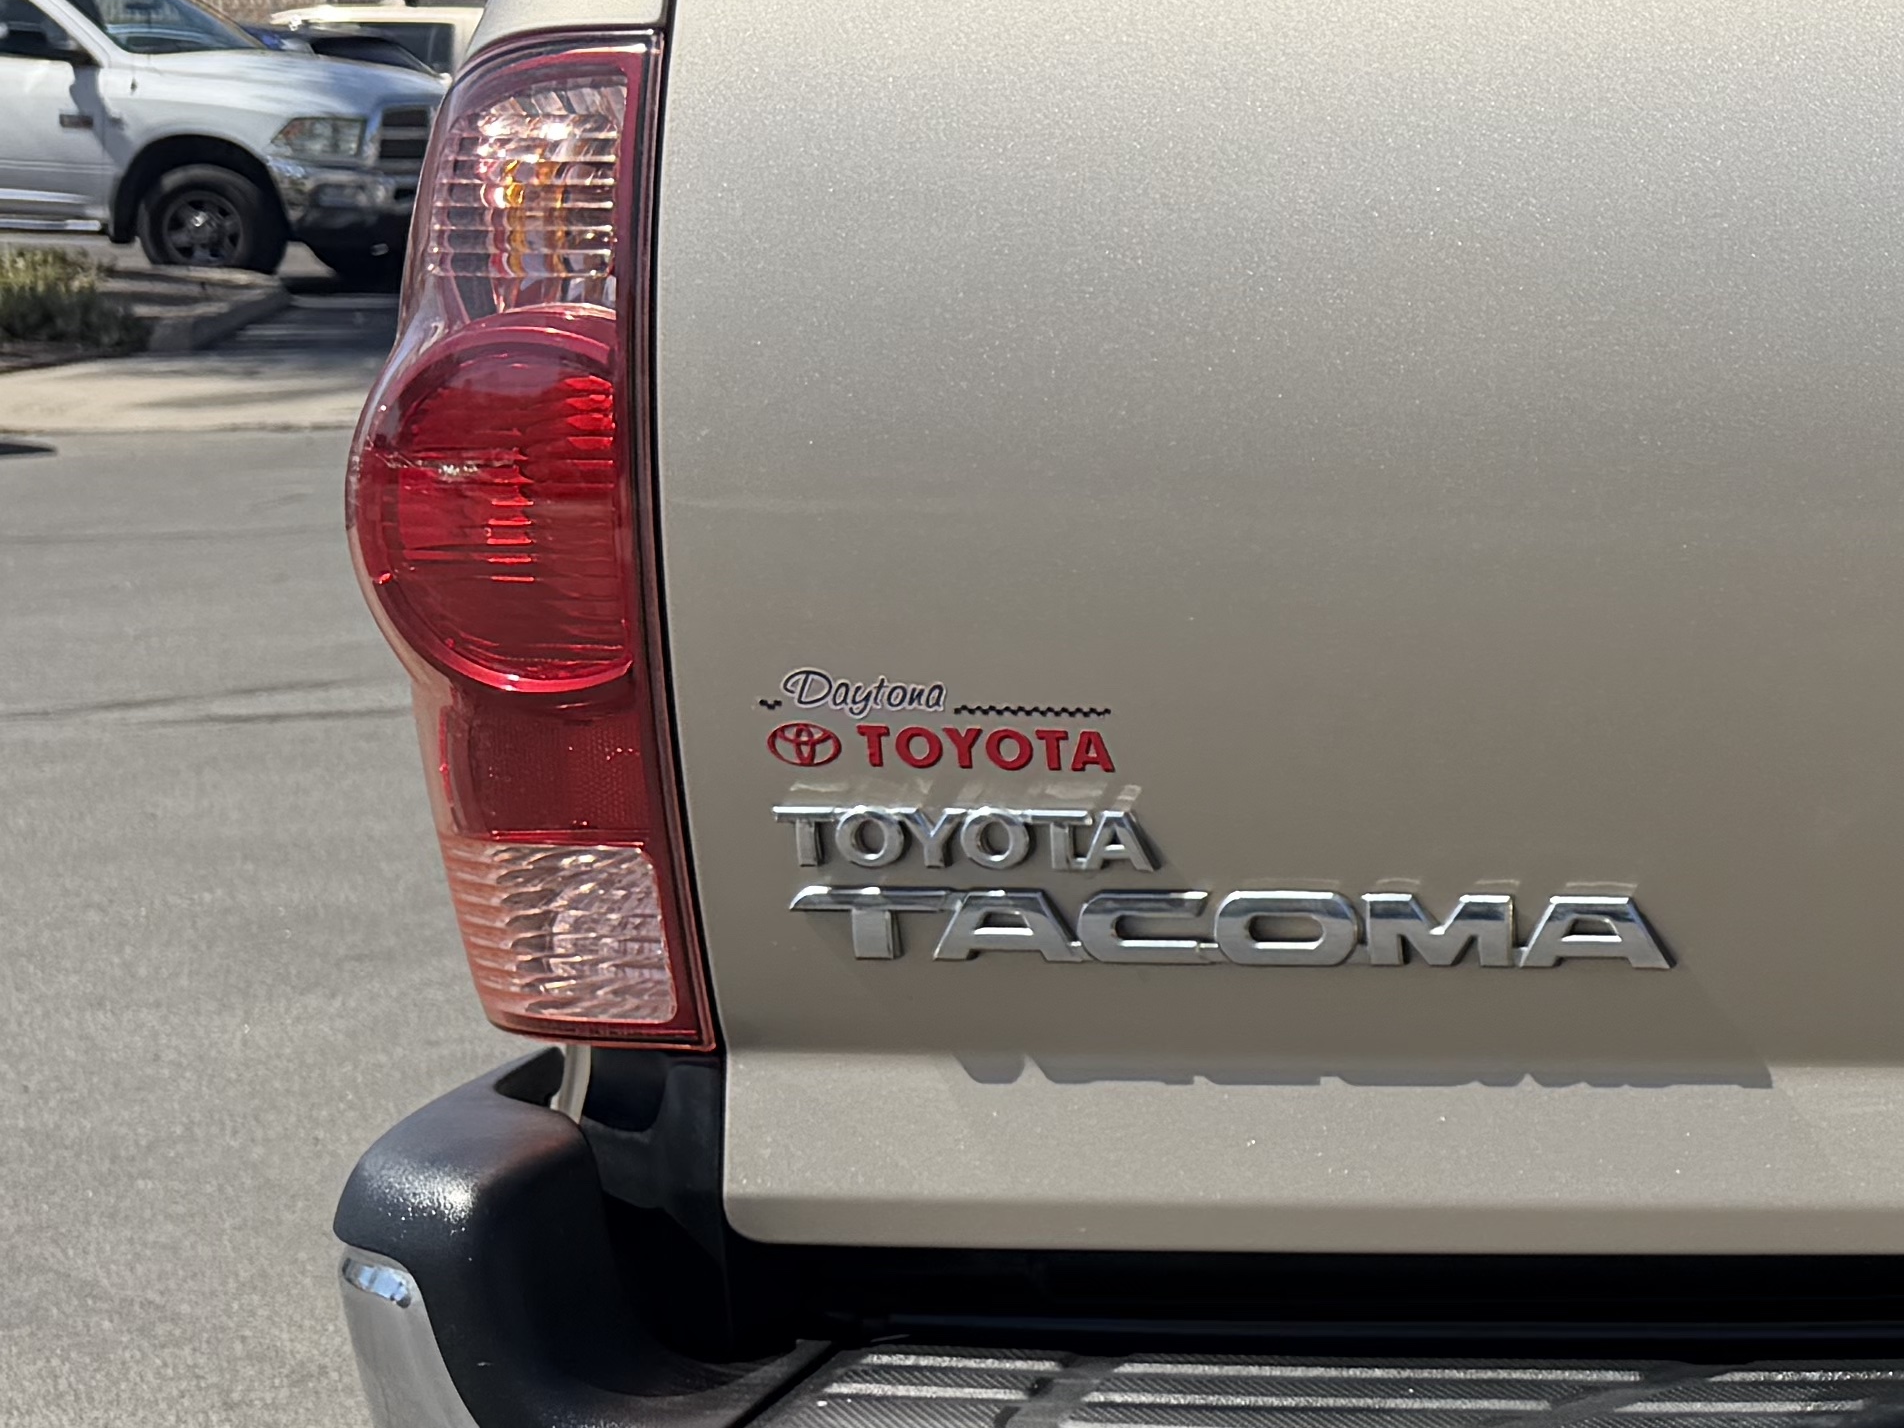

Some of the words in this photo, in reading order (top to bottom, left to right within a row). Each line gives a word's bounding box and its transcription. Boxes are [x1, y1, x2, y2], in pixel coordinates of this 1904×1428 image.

[781, 667, 948, 717] Daytona
[856, 724, 1115, 773] TOYOTA
[772, 804, 1162, 872] TOYOTA
[789, 884, 1678, 970] TACOMA
